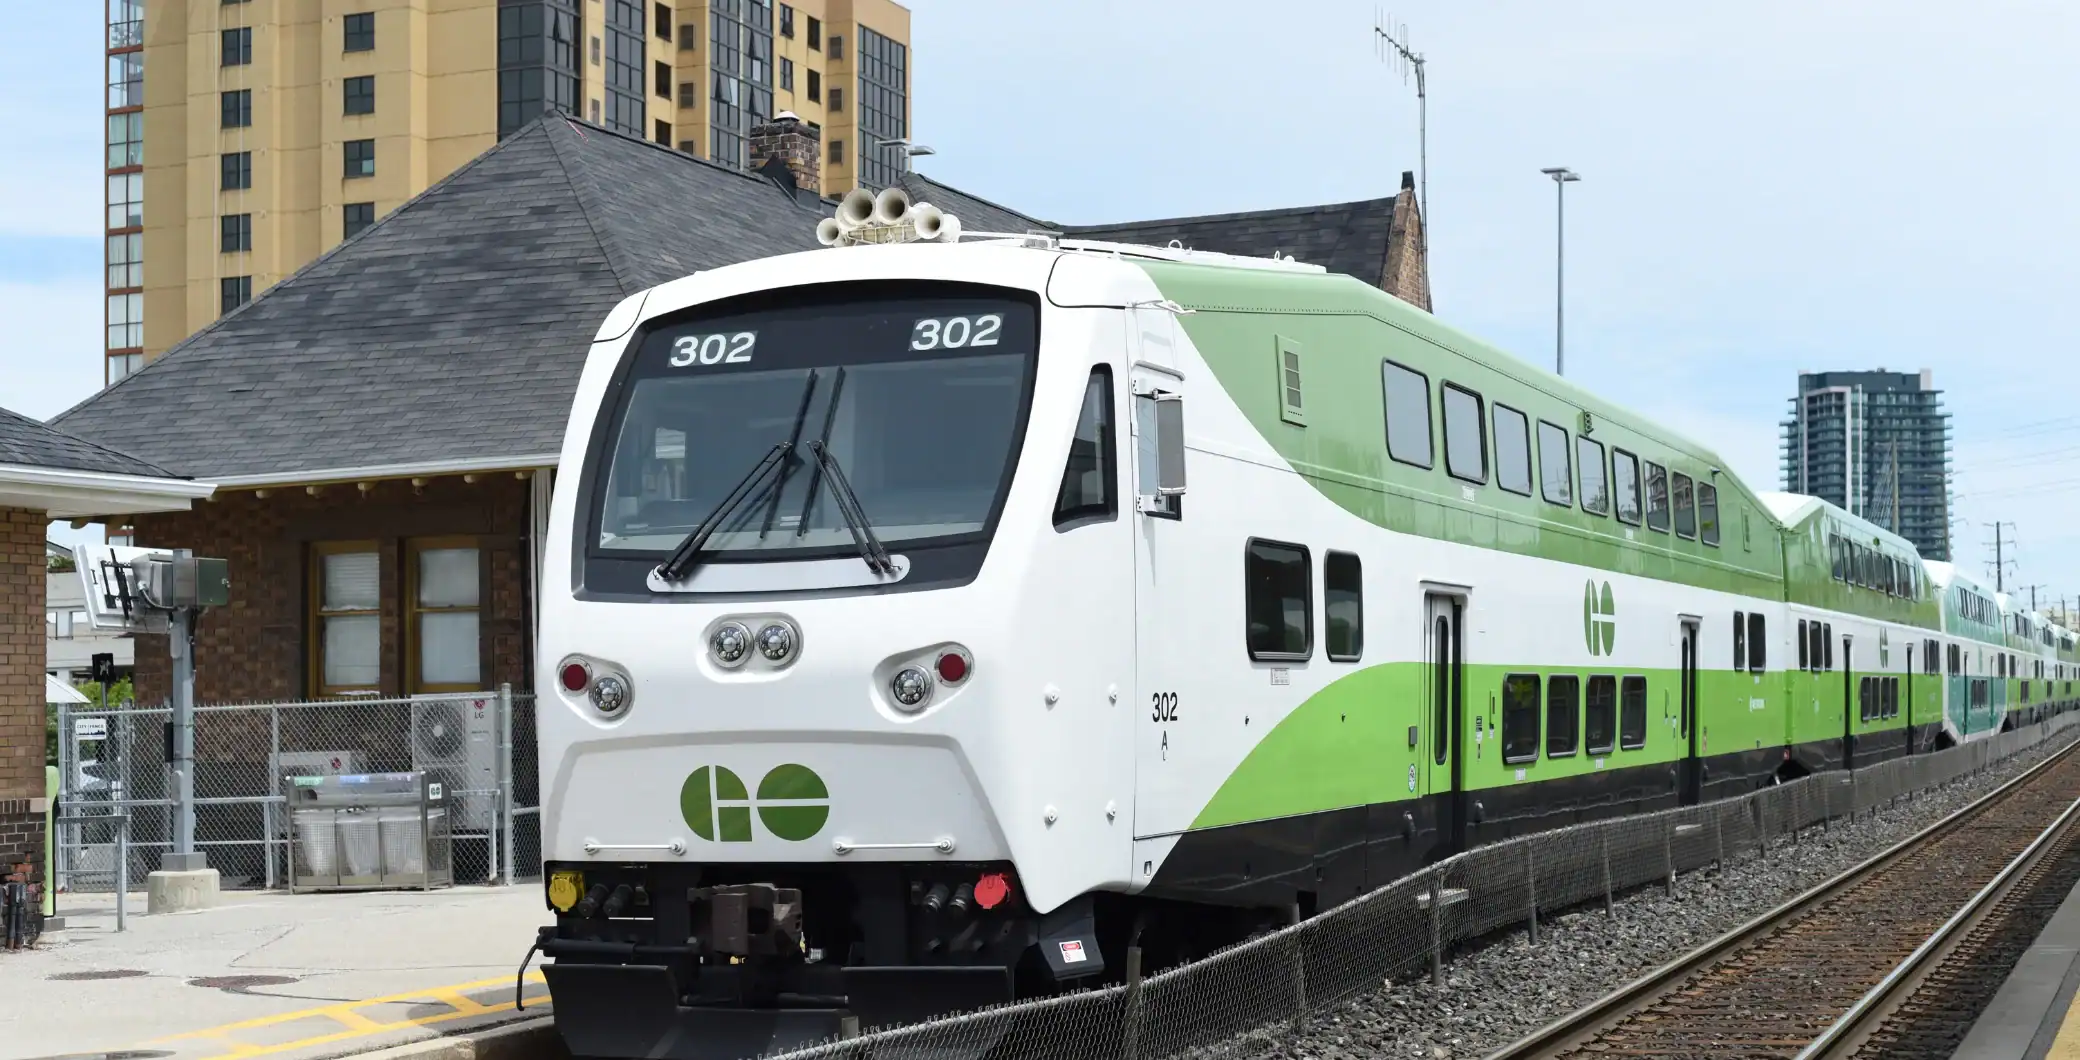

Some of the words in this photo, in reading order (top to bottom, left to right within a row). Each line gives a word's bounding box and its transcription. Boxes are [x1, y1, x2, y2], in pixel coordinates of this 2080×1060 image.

[670, 332, 756, 366] 302
[911, 315, 1001, 350] 302
[1584, 578, 1616, 657] GO
[474, 711, 485, 719] LG
[1152, 692, 1178, 722] 302
[1161, 730, 1168, 751] A
[680, 763, 830, 842] GO
